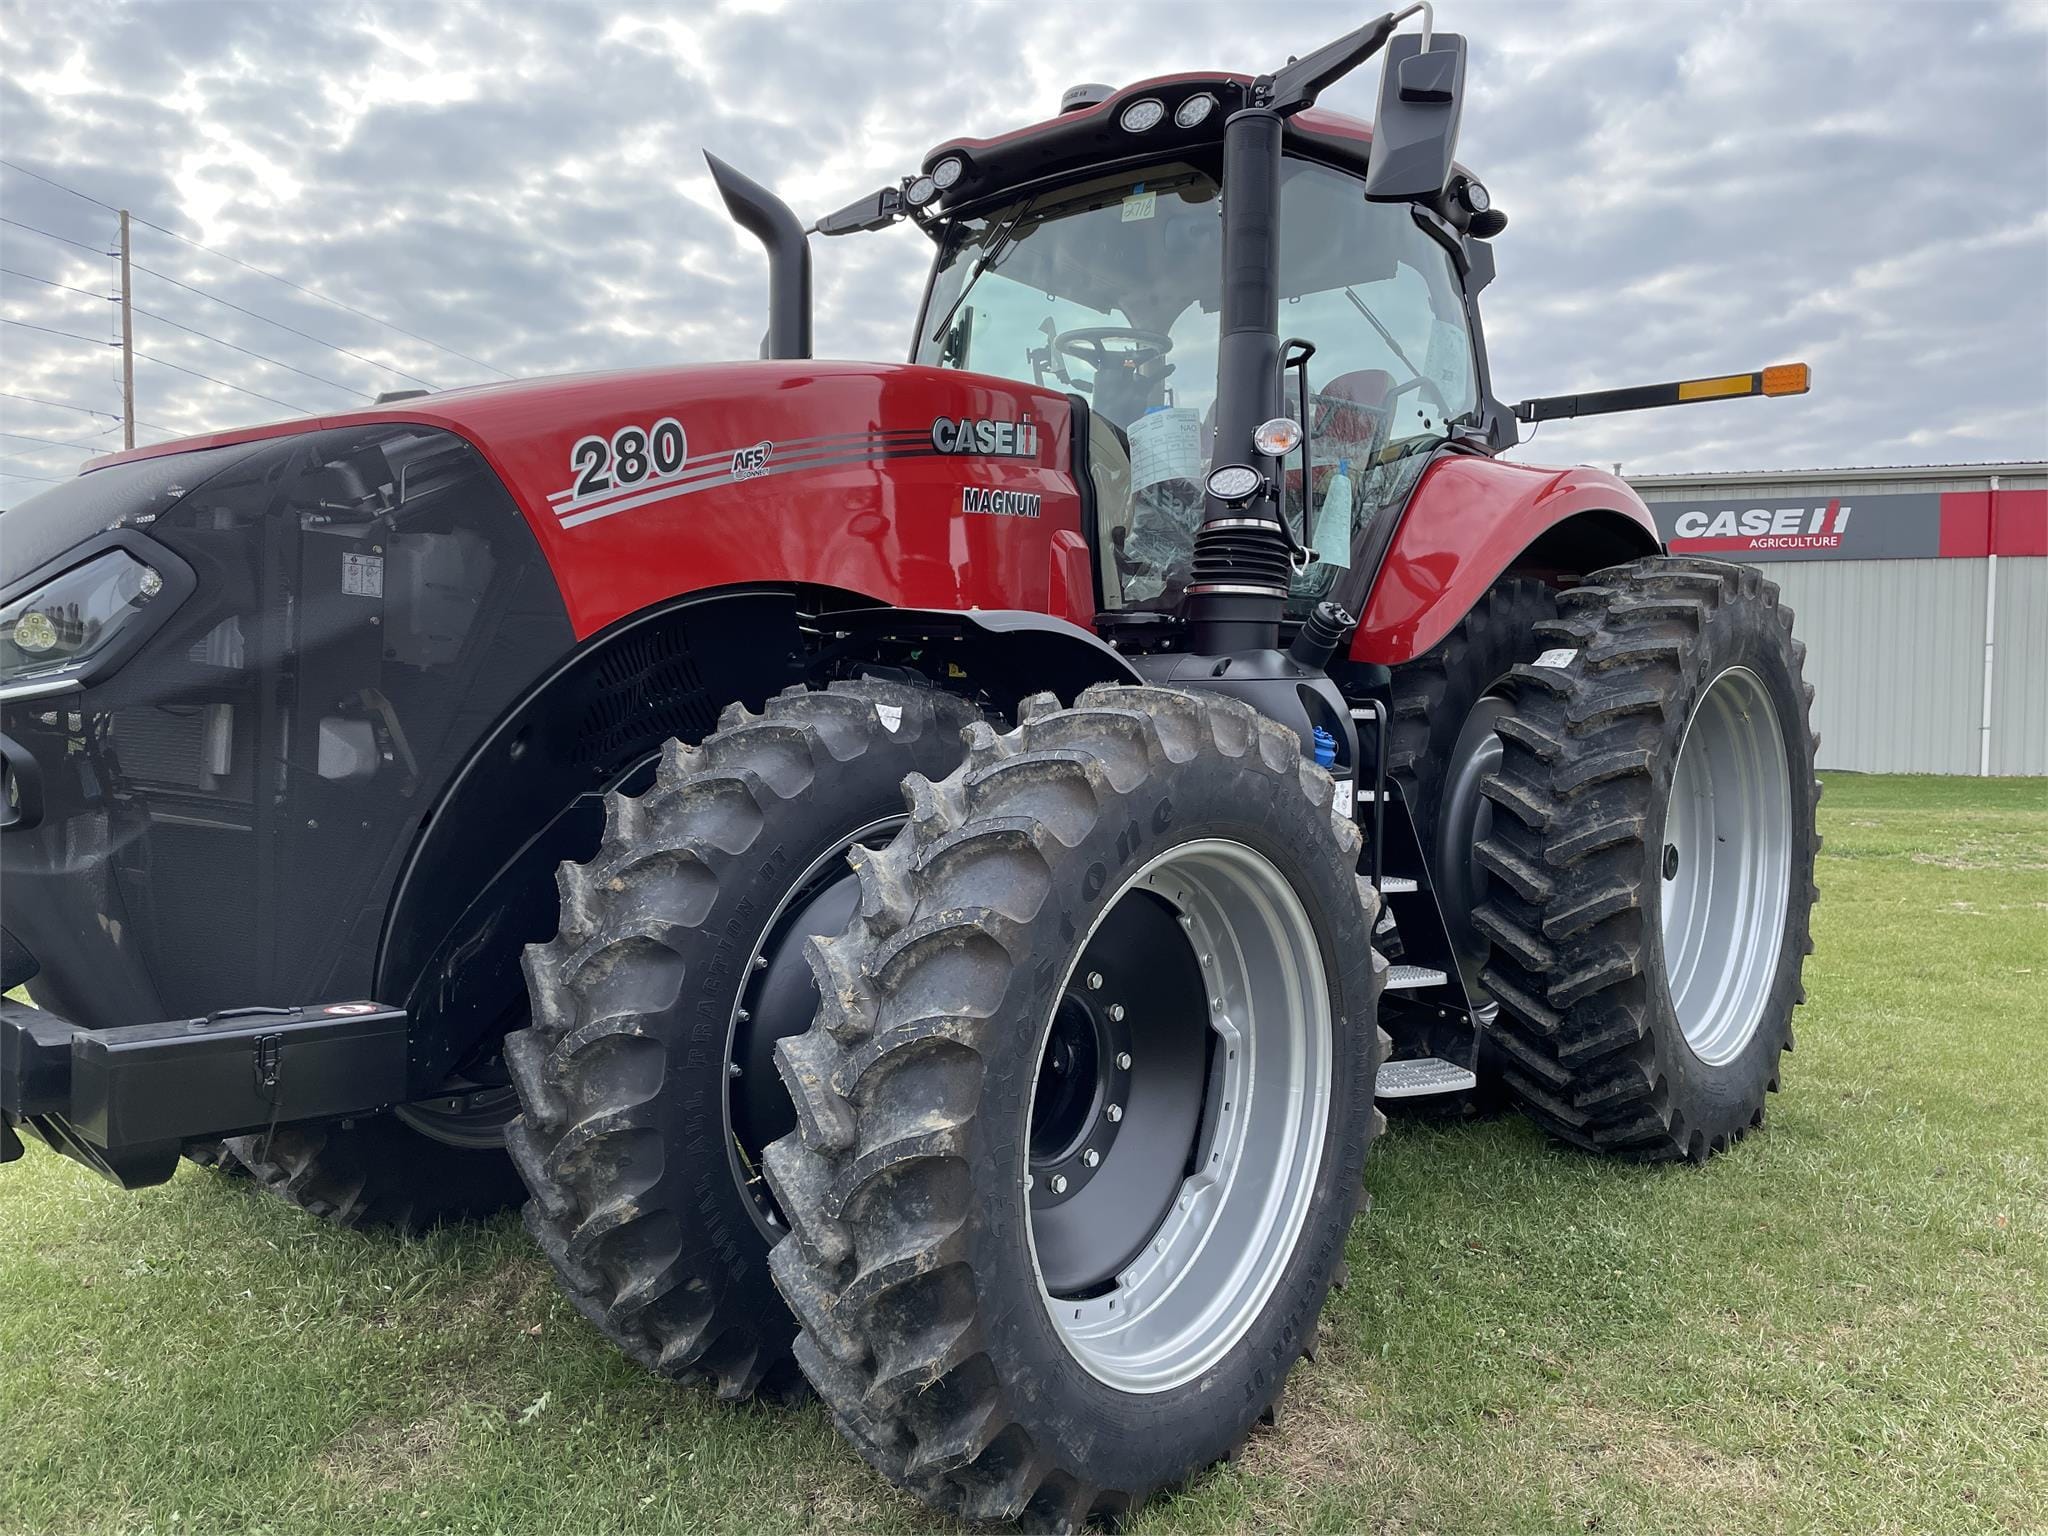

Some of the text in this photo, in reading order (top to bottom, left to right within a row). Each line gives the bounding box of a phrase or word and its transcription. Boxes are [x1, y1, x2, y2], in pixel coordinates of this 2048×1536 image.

[1124, 198, 1153, 218] 2718
[932, 416, 1013, 455] CASE
[571, 417, 687, 501] 280
[732, 446, 766, 471] AFS
[742, 467, 769, 479] CONNECT
[963, 487, 1041, 518] MAGNUM
[1675, 508, 1805, 538] CASE
[1749, 536, 1838, 549] AGRICULTURE
[687, 895, 755, 1070] TRACTION
[758, 843, 788, 883] DT
